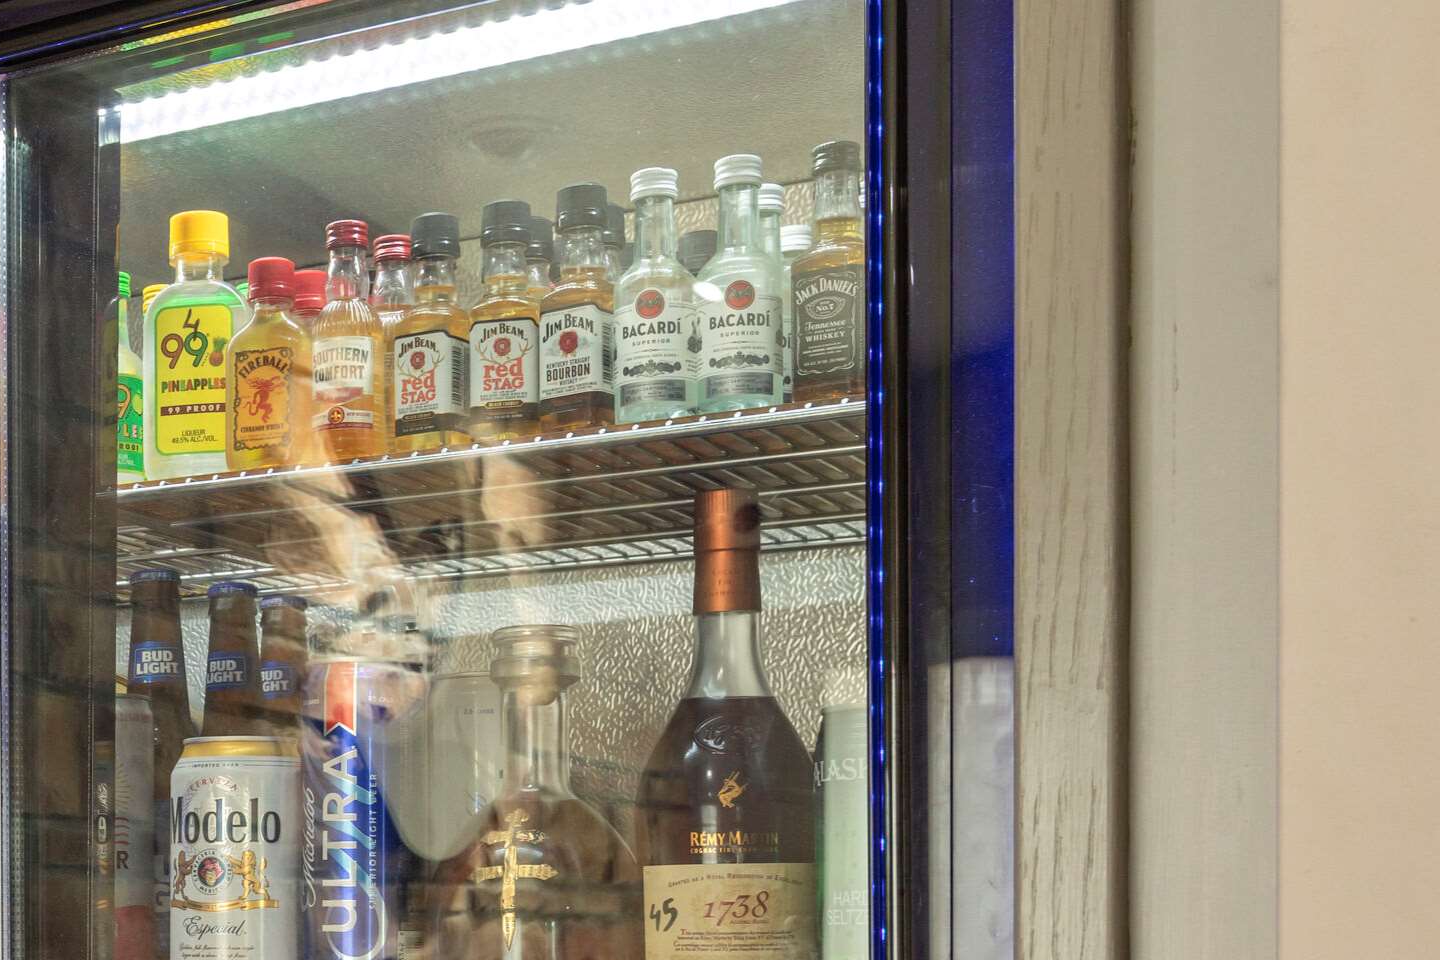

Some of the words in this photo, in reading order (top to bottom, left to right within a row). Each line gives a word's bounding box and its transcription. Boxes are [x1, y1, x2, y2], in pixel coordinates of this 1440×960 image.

[795, 284, 819, 305] JACK
[819, 278, 858, 297] DANIEL'S
[543, 319, 561, 343] JIM
[564, 314, 594, 336] BEAM
[622, 318, 682, 339] BACARDÍ
[710, 310, 771, 330] BACARDÍ
[805, 320, 846, 331] Tennessee
[480, 327, 498, 343] JIM
[499, 323, 524, 337] BEAM
[632, 338, 671, 346] SUPERIOR
[720, 330, 760, 338] SUPERIOR
[805, 331, 846, 343] WHISKEY
[161, 331, 209, 370] 99
[399, 342, 413, 358] JIM
[415, 337, 436, 351] BEAM
[239, 354, 291, 378] FIREBALL
[313, 347, 369, 369] SOUTHERN
[483, 357, 524, 378] red
[315, 365, 365, 383] COMFORT
[401, 368, 435, 393] red
[546, 364, 591, 382] BOURBON
[161, 377, 226, 393] PINEAPPLES
[483, 377, 524, 391] STAG
[401, 389, 435, 404] STAG
[168, 407, 180, 415] 99
[186, 405, 221, 413] PROOF
[142, 650, 173, 663] BUD
[209, 660, 238, 673] BUD
[136, 662, 179, 675] LIGHT
[171, 797, 281, 844] Modelo
[368, 810, 377, 844] LIGHT
[322, 748, 357, 932] ULTRA
[649, 897, 679, 932] 45
[704, 890, 771, 926] 1738
[183, 916, 247, 940] Especial
